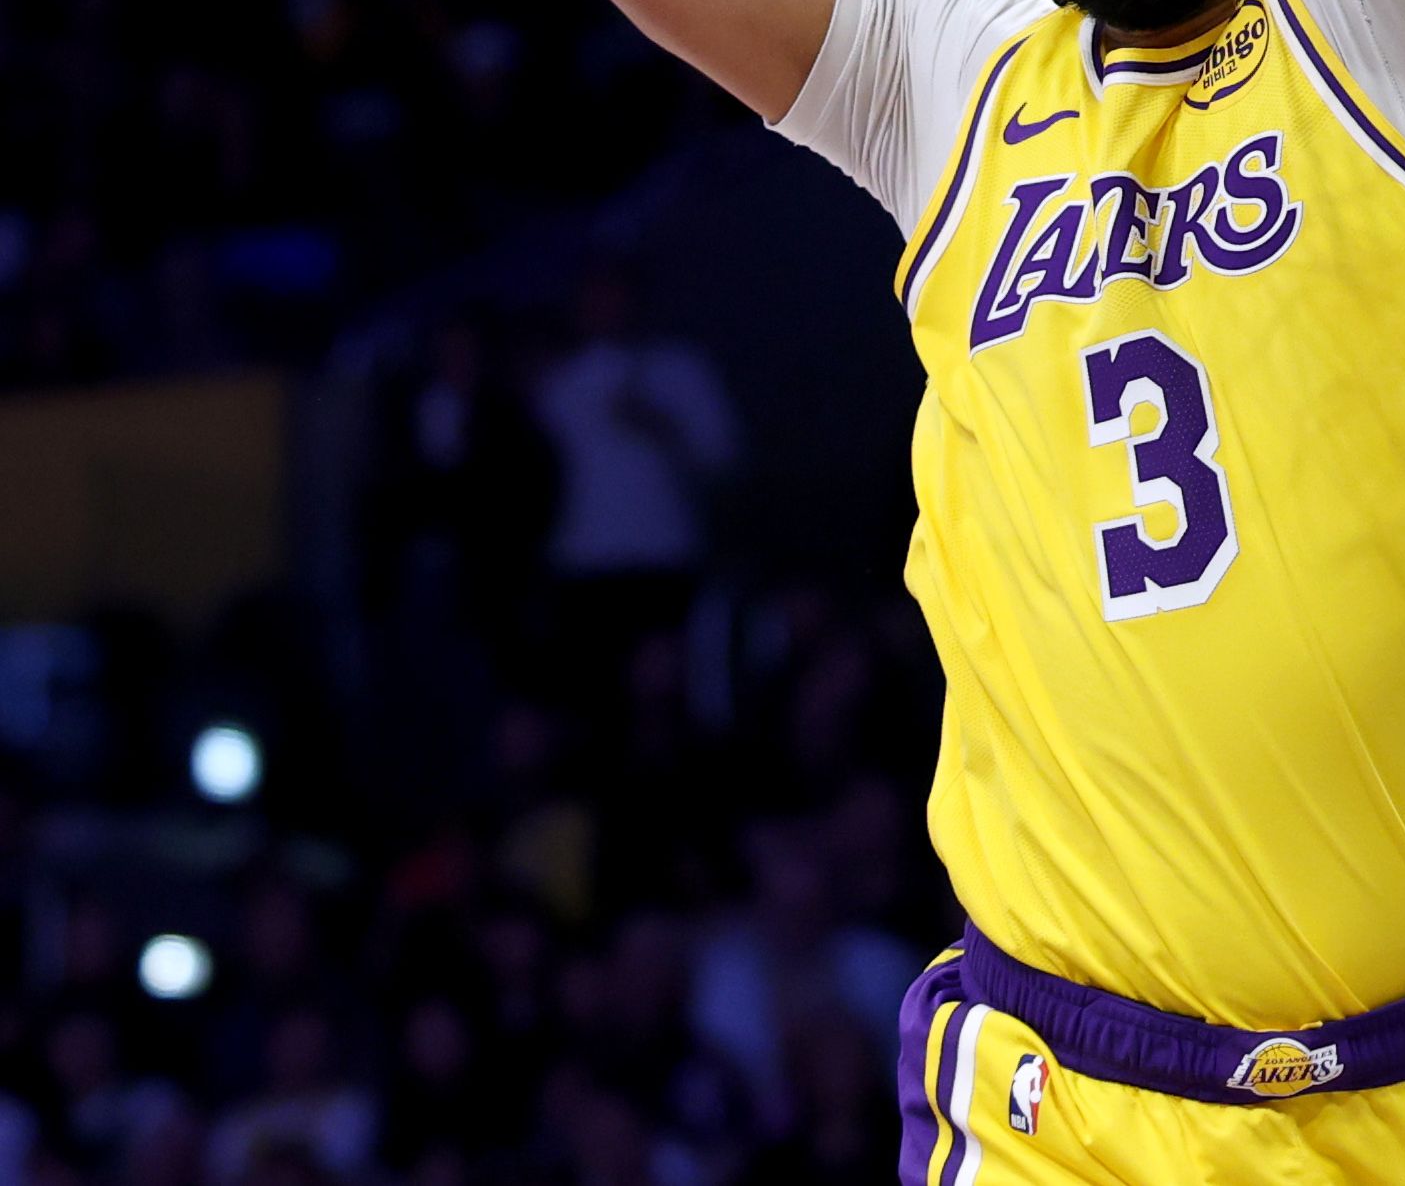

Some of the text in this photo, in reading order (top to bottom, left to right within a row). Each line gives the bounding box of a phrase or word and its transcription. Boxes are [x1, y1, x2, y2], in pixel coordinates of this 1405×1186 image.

[1203, 59, 1238, 89] 비비고
[1080, 327, 1241, 623] 3
[1265, 1049, 1334, 1065] LOS ANGELES
[1236, 1058, 1336, 1087] LAKERS
